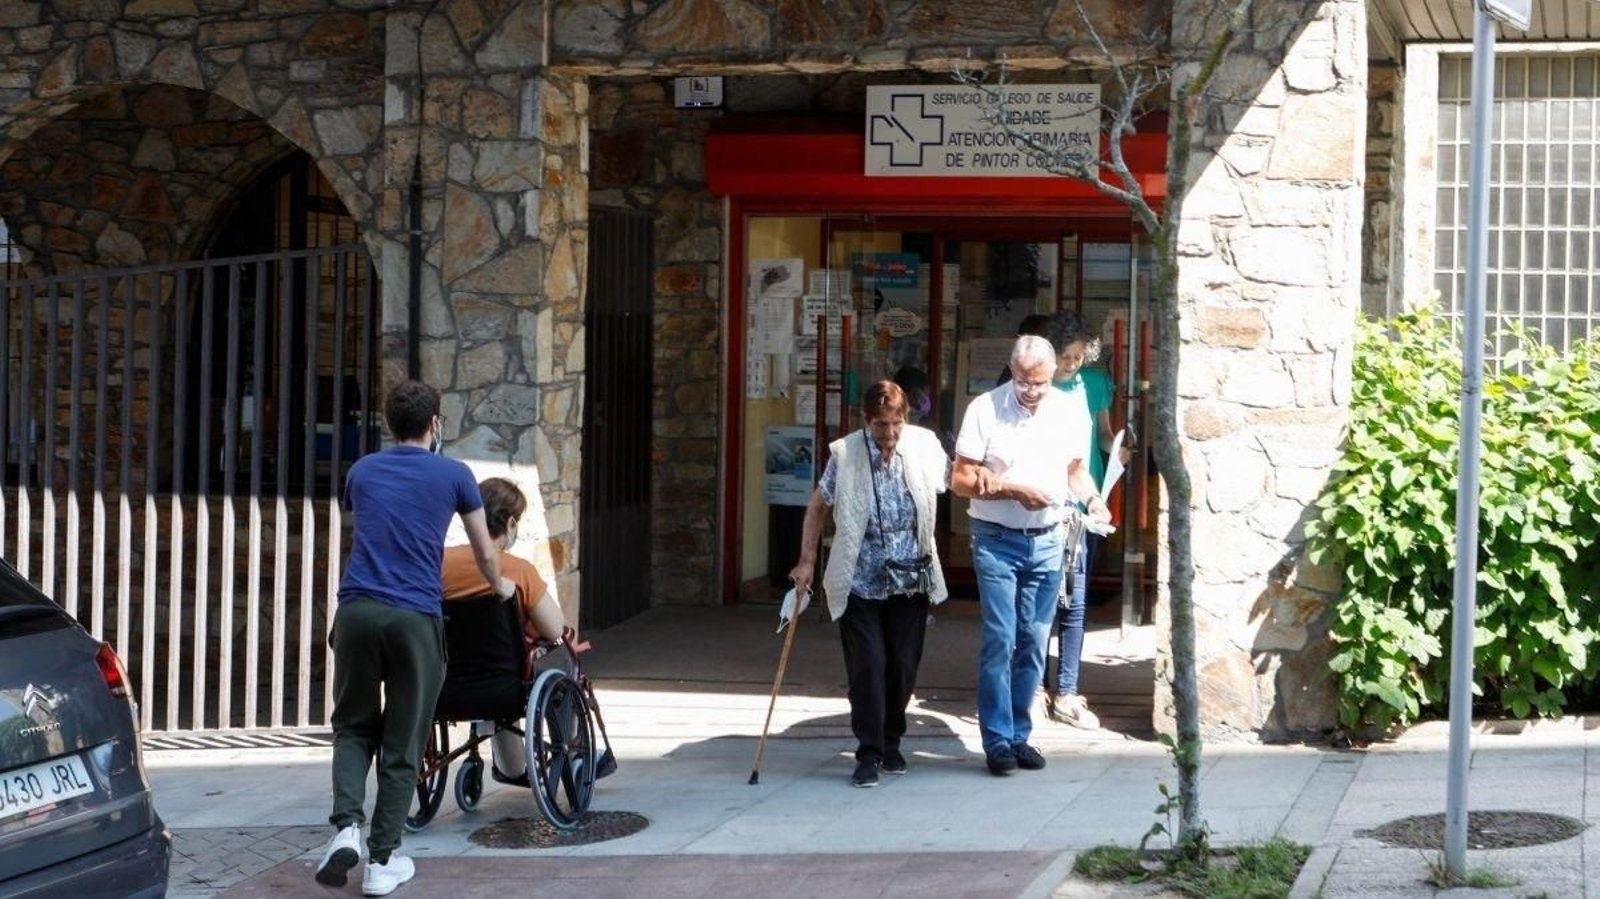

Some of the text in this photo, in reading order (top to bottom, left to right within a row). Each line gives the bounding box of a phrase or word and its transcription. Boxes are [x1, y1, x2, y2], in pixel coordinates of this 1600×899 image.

[931, 92, 981, 104] SERVICIO
[1036, 92, 1052, 104] DE
[1057, 92, 1094, 104] SAUDE
[948, 132, 1015, 147] ATENCION
[945, 153, 964, 167] DE
[972, 153, 1020, 168] PINTOR
[50, 763, 87, 794] JRL
